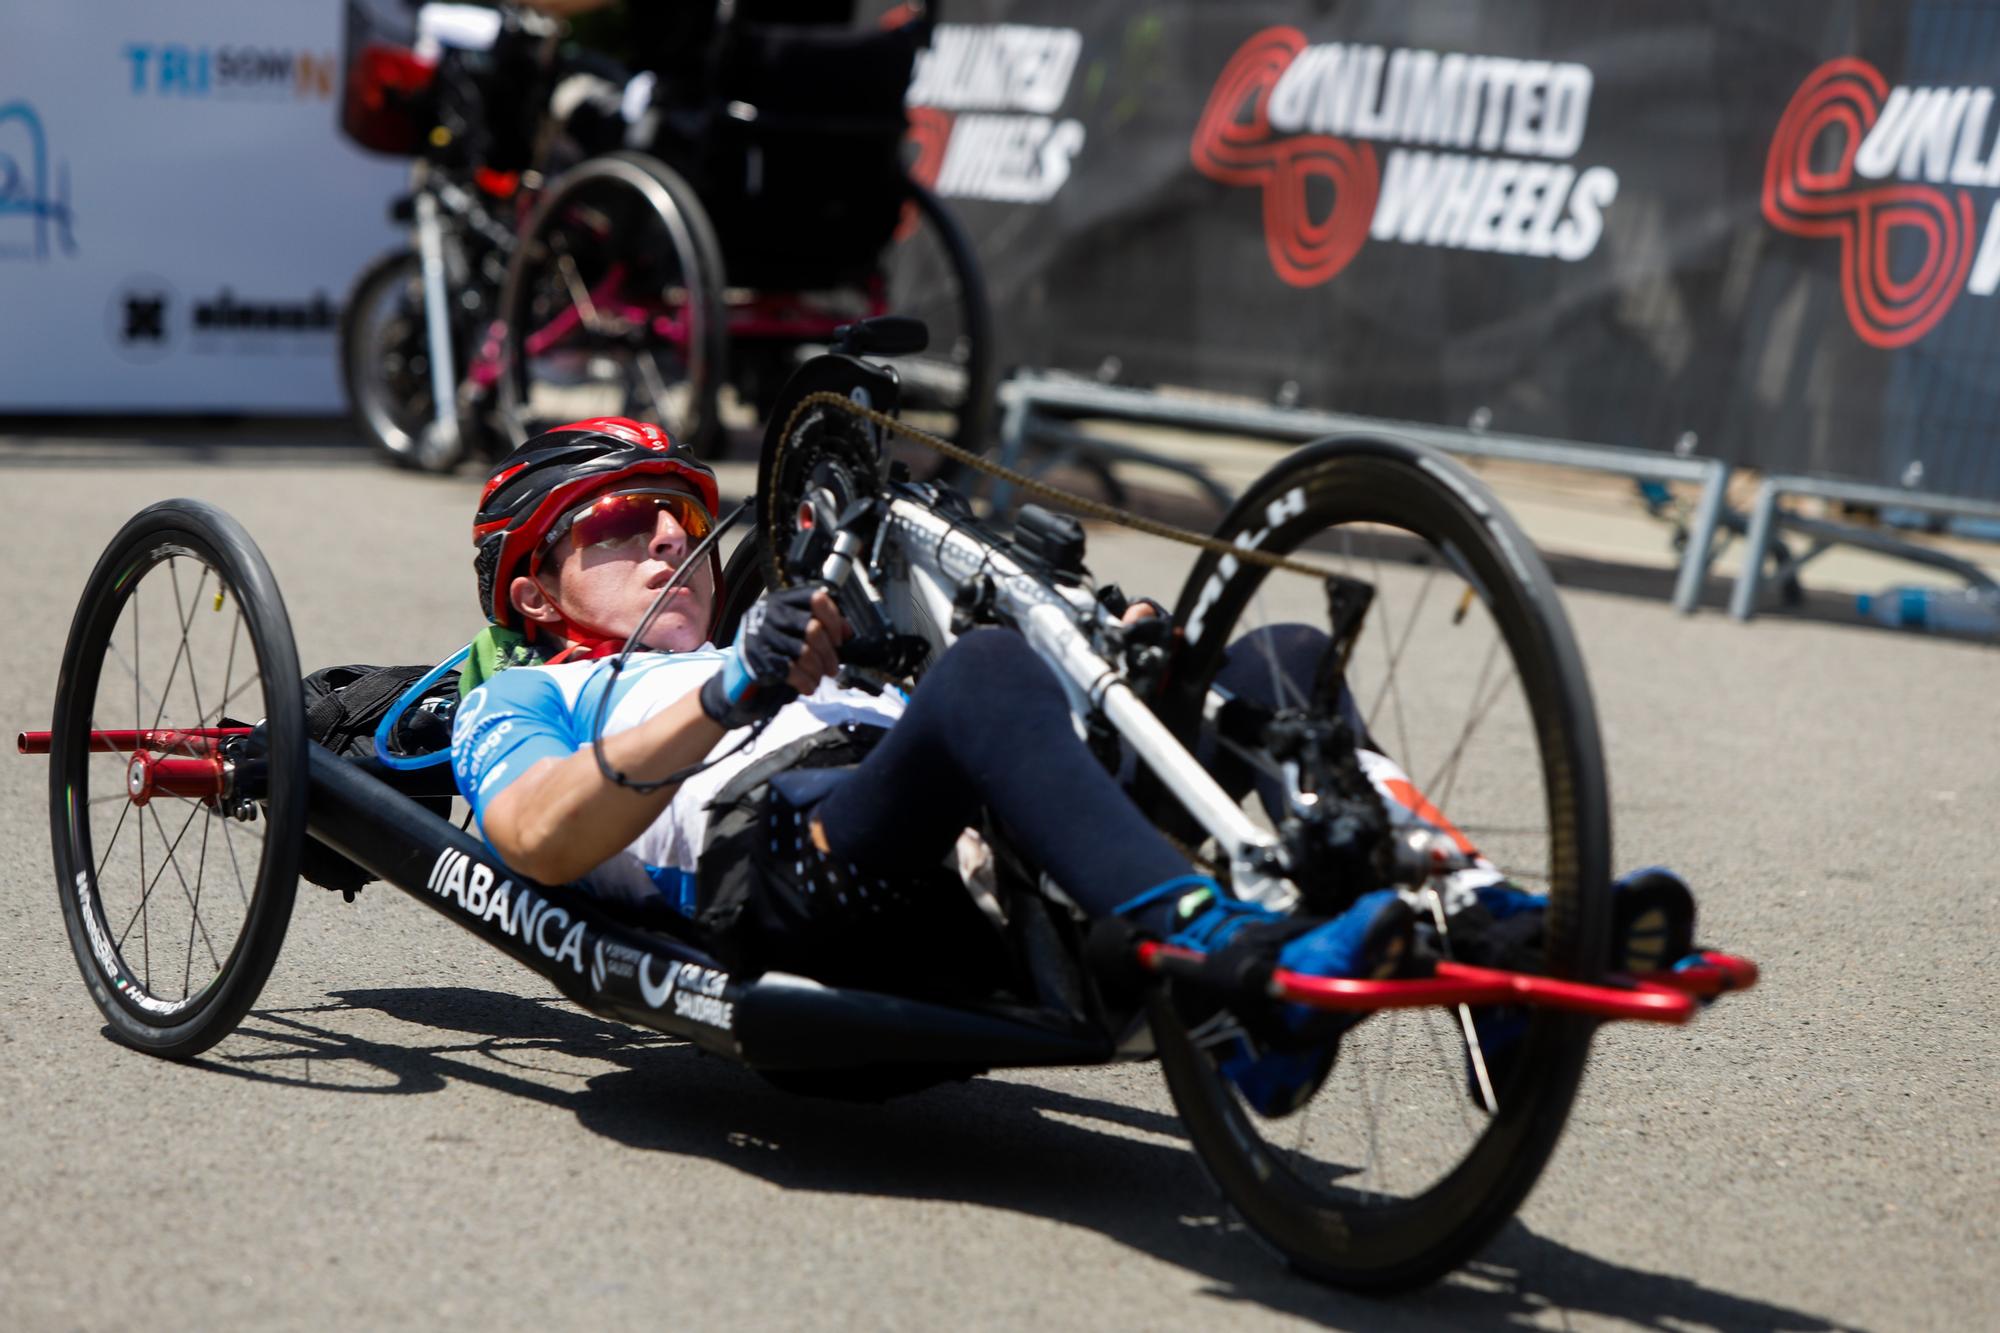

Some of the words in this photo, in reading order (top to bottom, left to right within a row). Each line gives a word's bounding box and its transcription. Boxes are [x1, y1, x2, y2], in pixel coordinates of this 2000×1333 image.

[1268, 43, 1593, 158] UNLIMITED
[935, 115, 1085, 202] WHEELS
[1370, 149, 1618, 261] WHEELS
